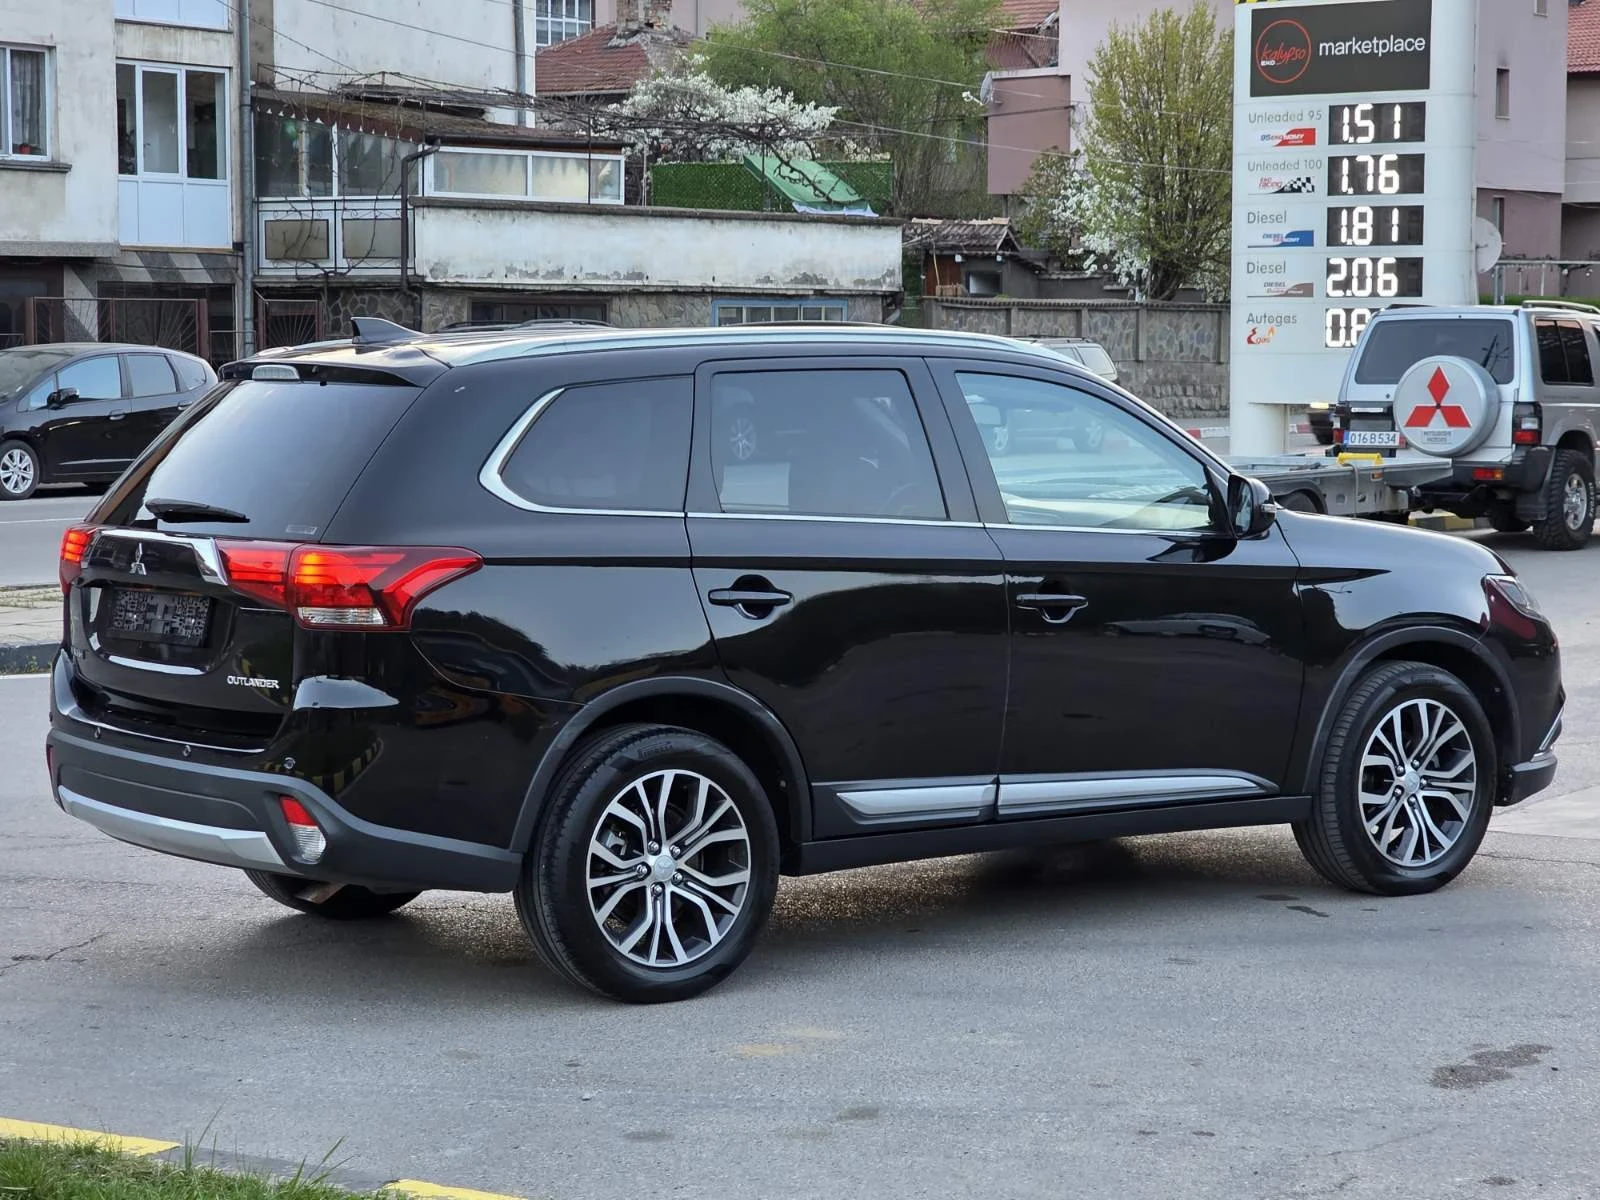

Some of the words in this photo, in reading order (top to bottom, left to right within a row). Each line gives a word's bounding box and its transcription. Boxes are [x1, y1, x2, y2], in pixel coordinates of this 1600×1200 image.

[1319, 34, 1426, 57] marketplace
[1248, 109, 1304, 123] Unleaded
[1307, 110, 1322, 121] 95
[1342, 103, 1401, 144] 1.51
[1247, 158, 1300, 172] Unleaded
[1304, 159, 1322, 170] 100
[1341, 153, 1400, 195] 1.76
[1247, 209, 1287, 224] Diesel
[1340, 206, 1399, 246] 1.81
[1246, 260, 1286, 274] Diesel
[1326, 257, 1398, 297] 2.06
[1246, 312, 1297, 327] Autogas
[227, 675, 280, 689] OUTLANDER
